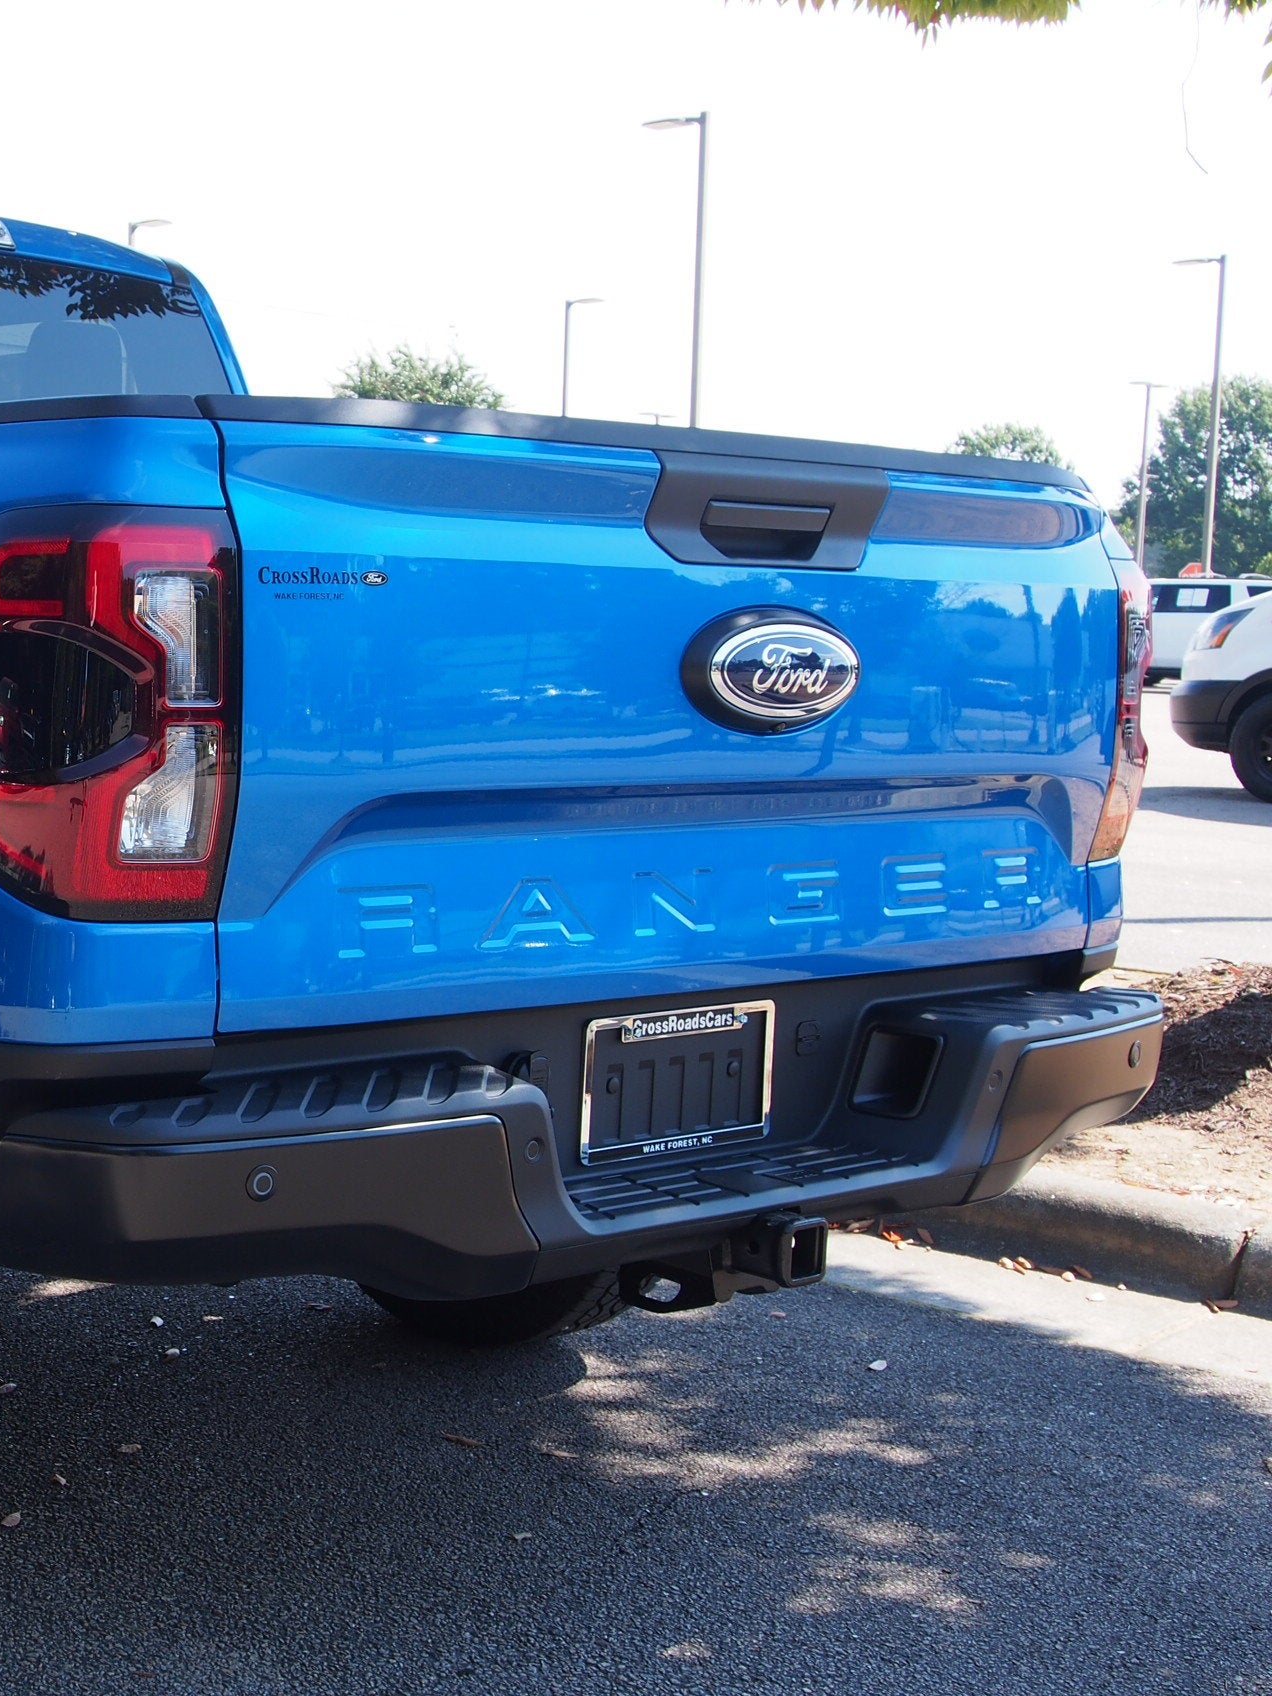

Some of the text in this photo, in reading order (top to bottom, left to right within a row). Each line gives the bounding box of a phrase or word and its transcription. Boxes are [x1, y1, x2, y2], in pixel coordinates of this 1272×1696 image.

[274, 592, 296, 600] WAKE
[334, 592, 344, 600] NC
[752, 643, 831, 695] Ford
[337, 848, 1042, 958] RANGER
[643, 1136, 713, 1153] WAKE FOREST, NC
